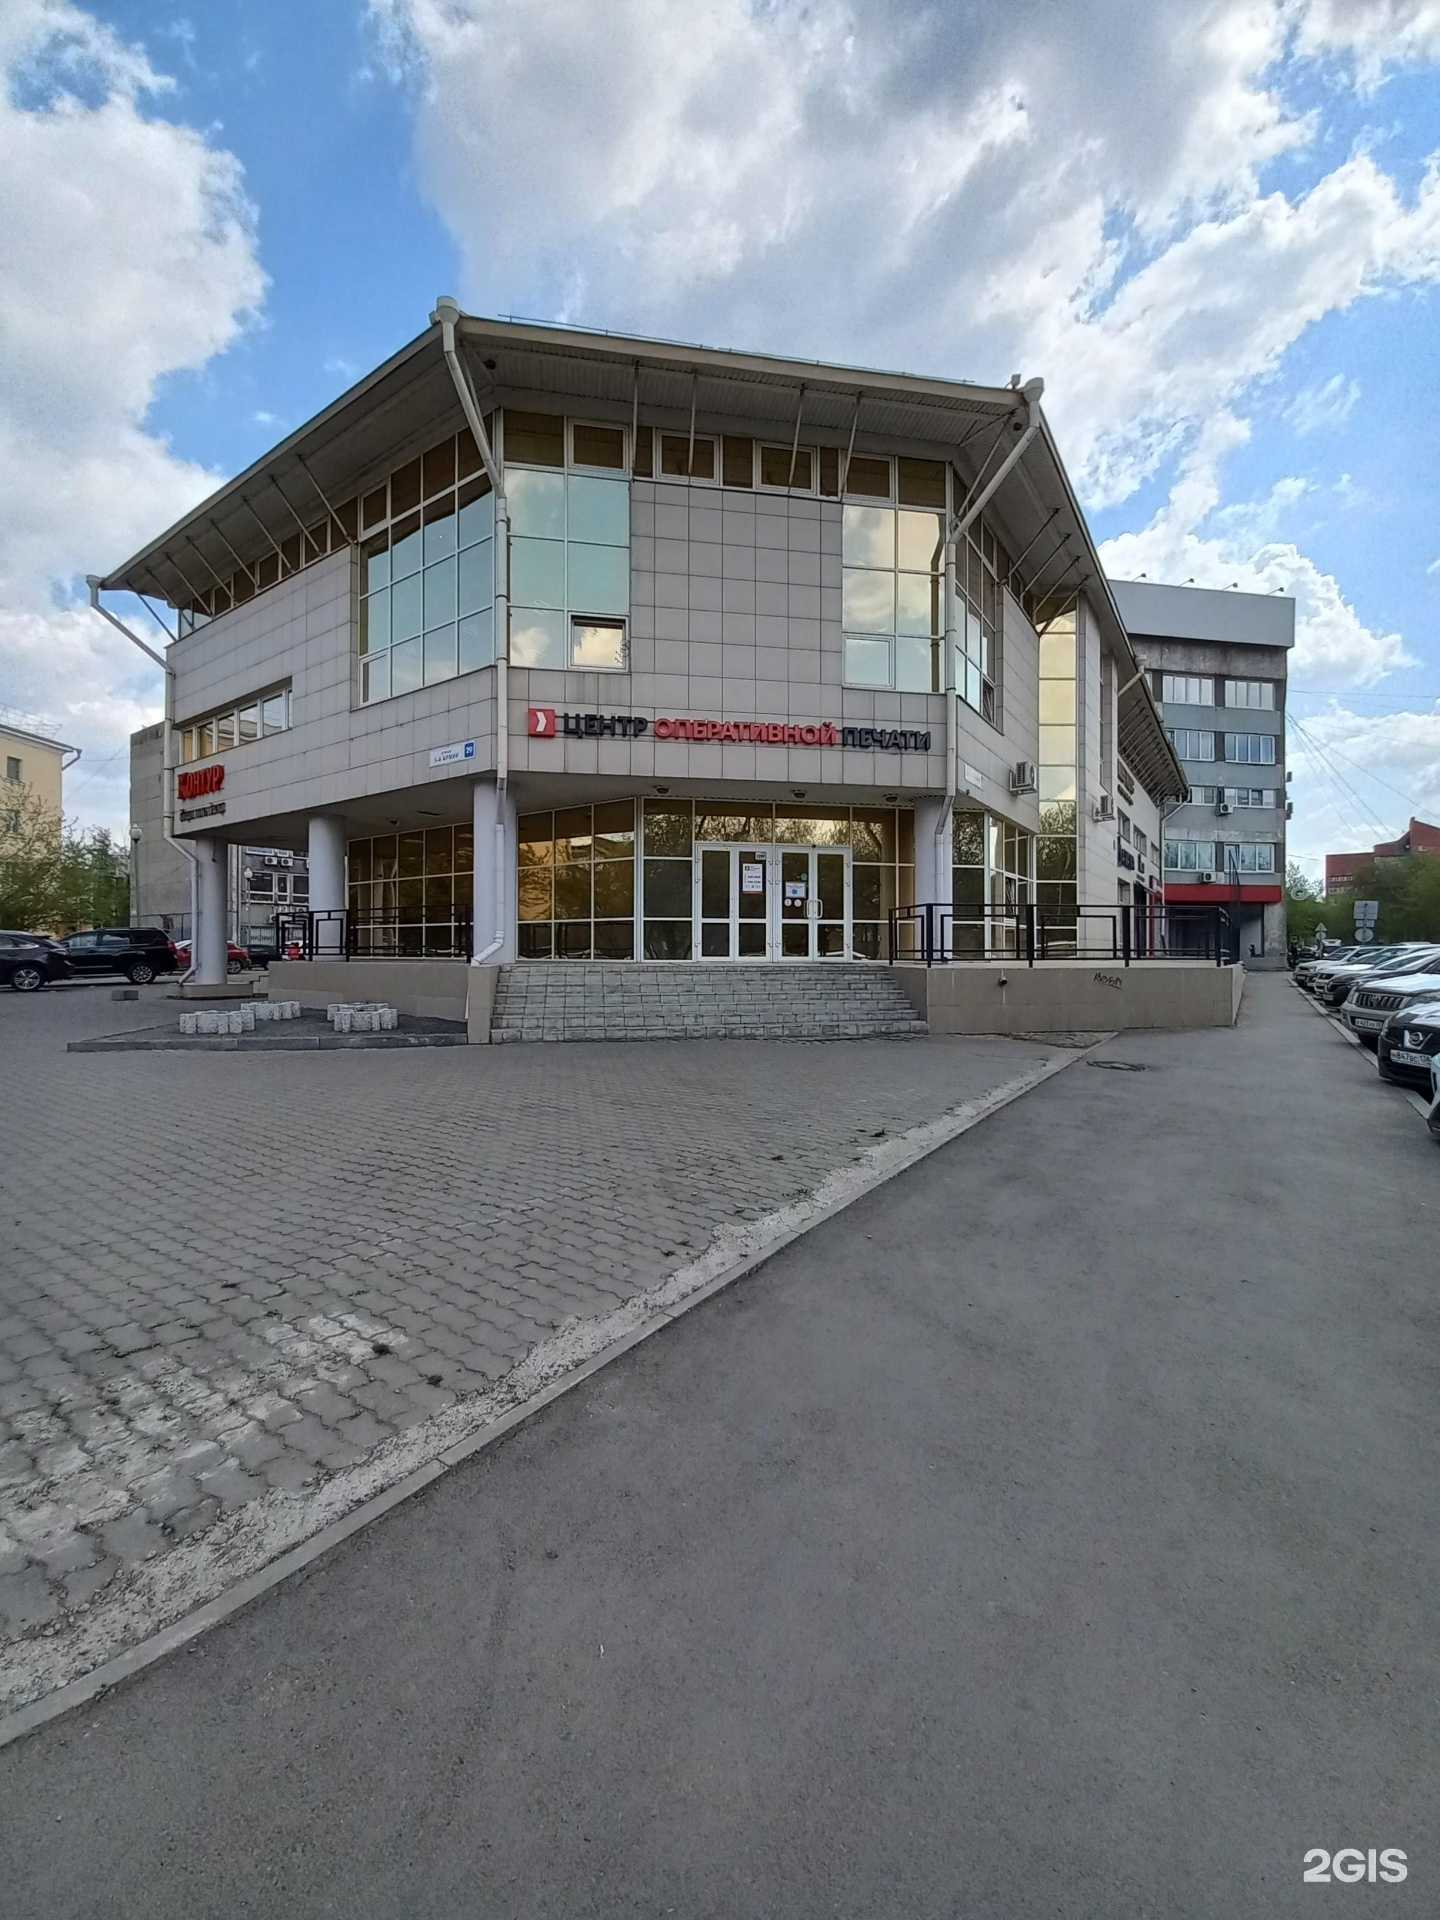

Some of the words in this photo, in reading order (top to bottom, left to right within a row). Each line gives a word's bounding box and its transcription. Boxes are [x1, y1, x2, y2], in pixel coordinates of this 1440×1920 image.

[563, 712, 648, 738] ЦЕНТР
[654, 717, 840, 748] ОПЕРАТИВНОЙ
[842, 726, 931, 751] ПЕЧАТИ
